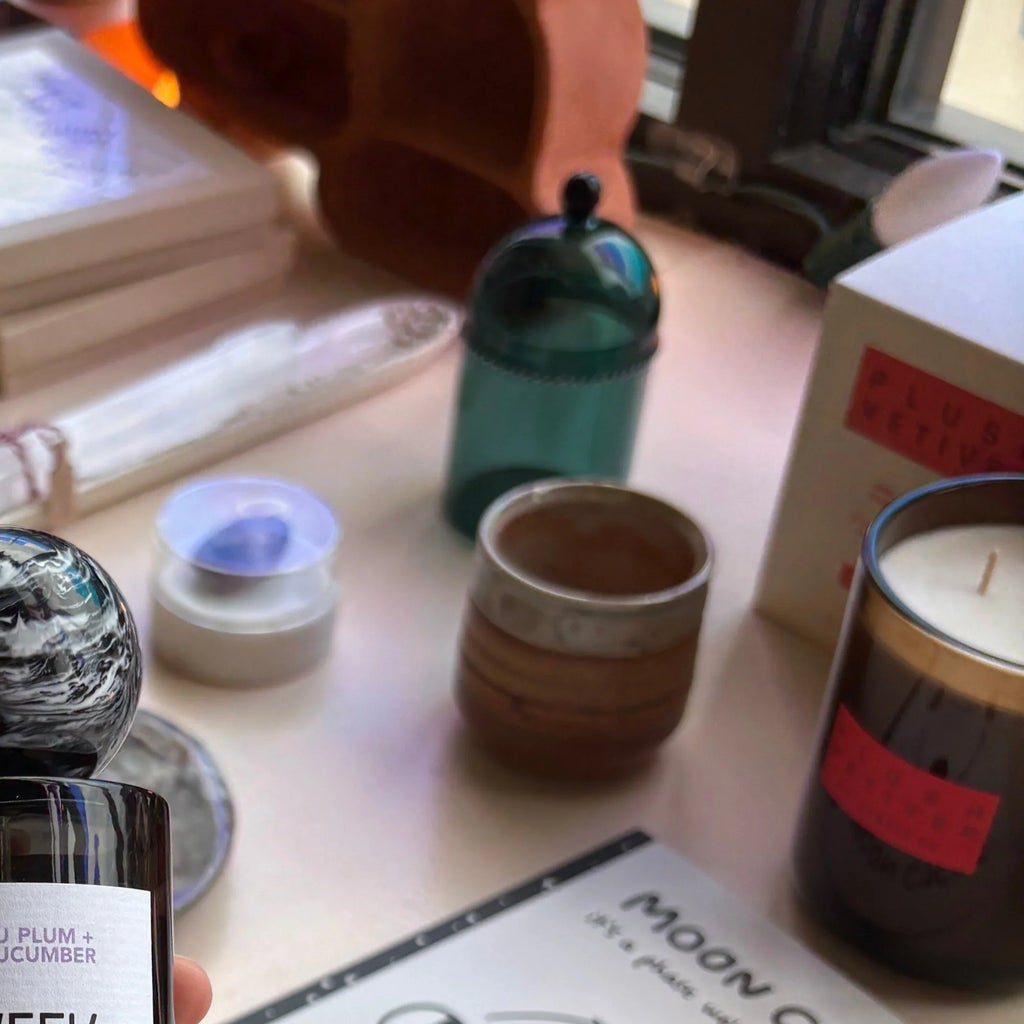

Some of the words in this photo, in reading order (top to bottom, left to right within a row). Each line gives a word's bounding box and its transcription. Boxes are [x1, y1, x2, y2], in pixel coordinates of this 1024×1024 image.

[18, 926, 76, 945] PLUM
[82, 932, 94, 944] +
[619, 893, 773, 999] MOON
